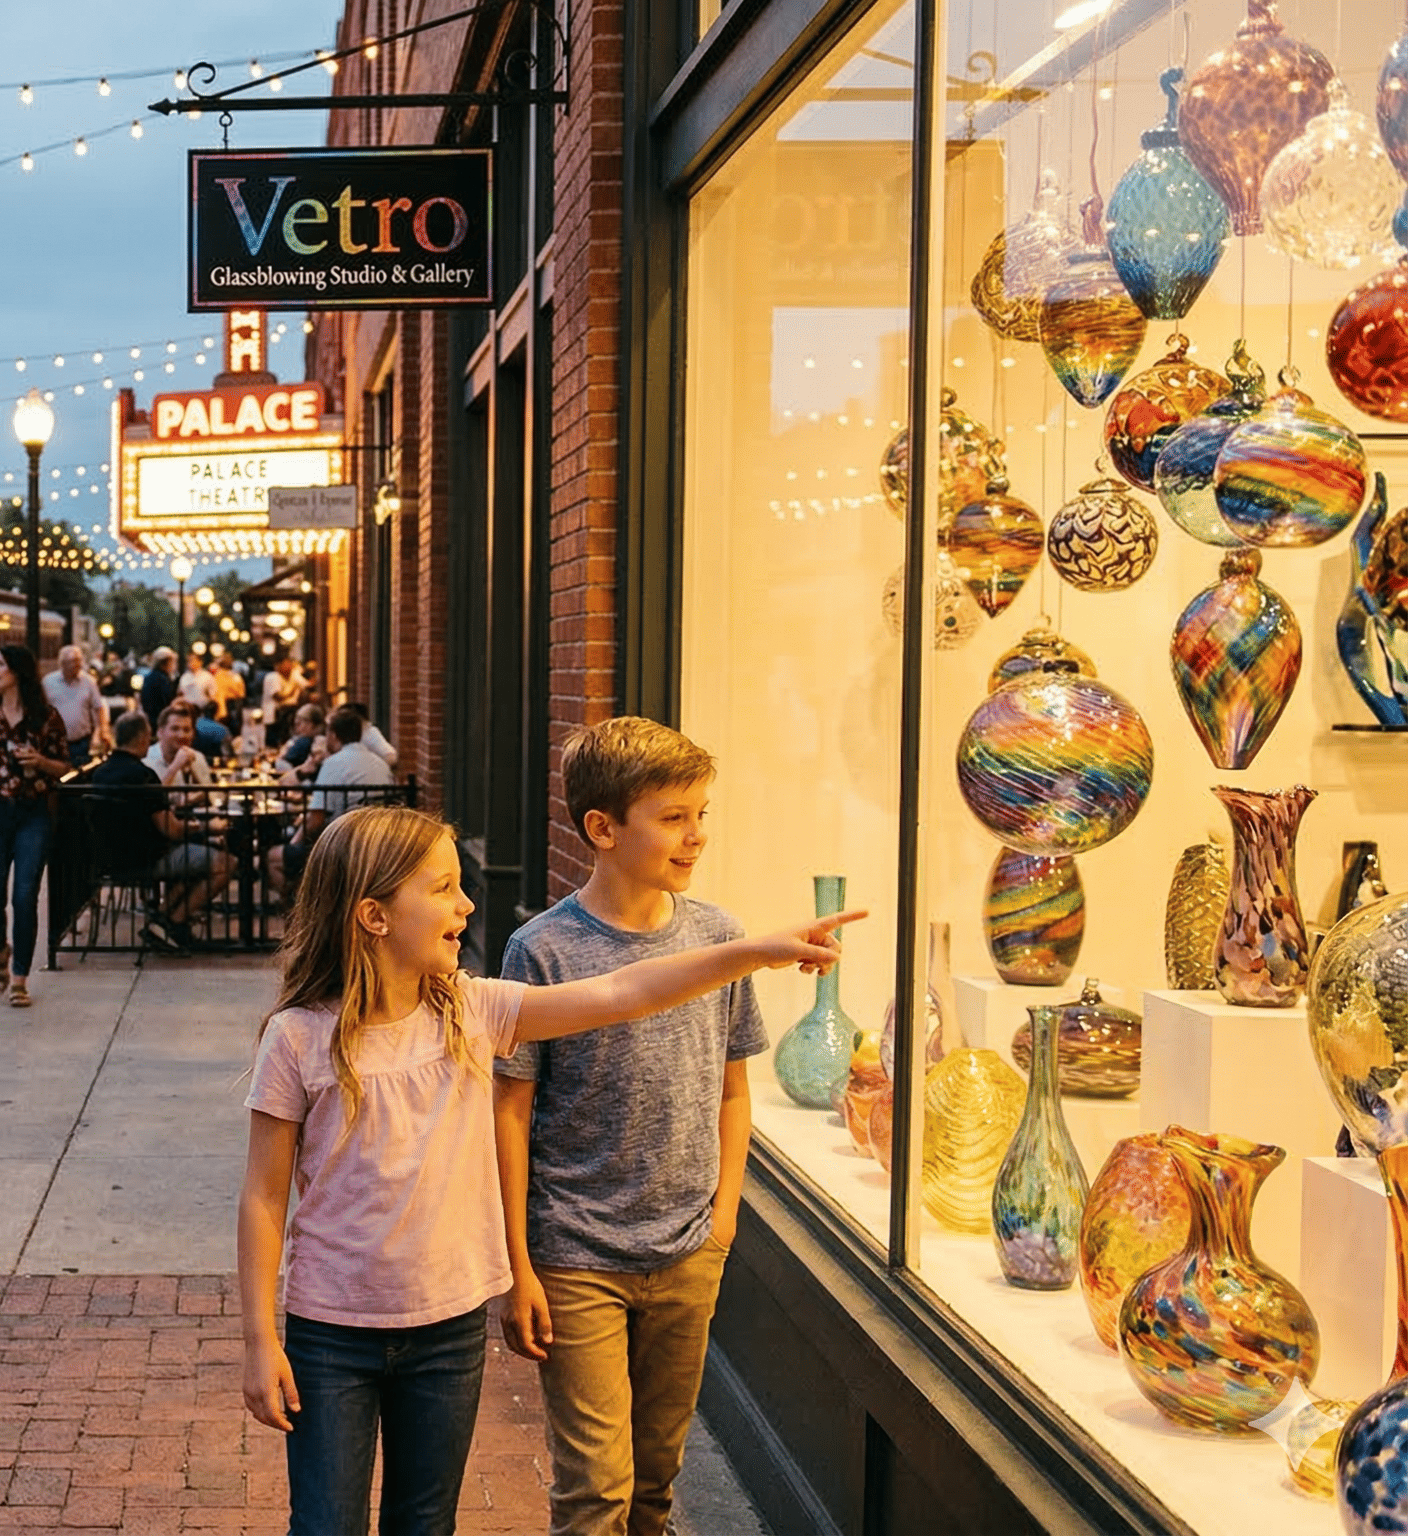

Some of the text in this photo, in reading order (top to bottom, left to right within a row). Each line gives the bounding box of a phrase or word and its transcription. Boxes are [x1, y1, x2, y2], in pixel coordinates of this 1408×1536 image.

[214, 176, 469, 256] Vetro
[210, 263, 475, 291] Glassblowing Studio & Gallery
[157, 390, 320, 439] PALACE
[190, 459, 268, 480] PALACE
[189, 486, 268, 508] THEATR
